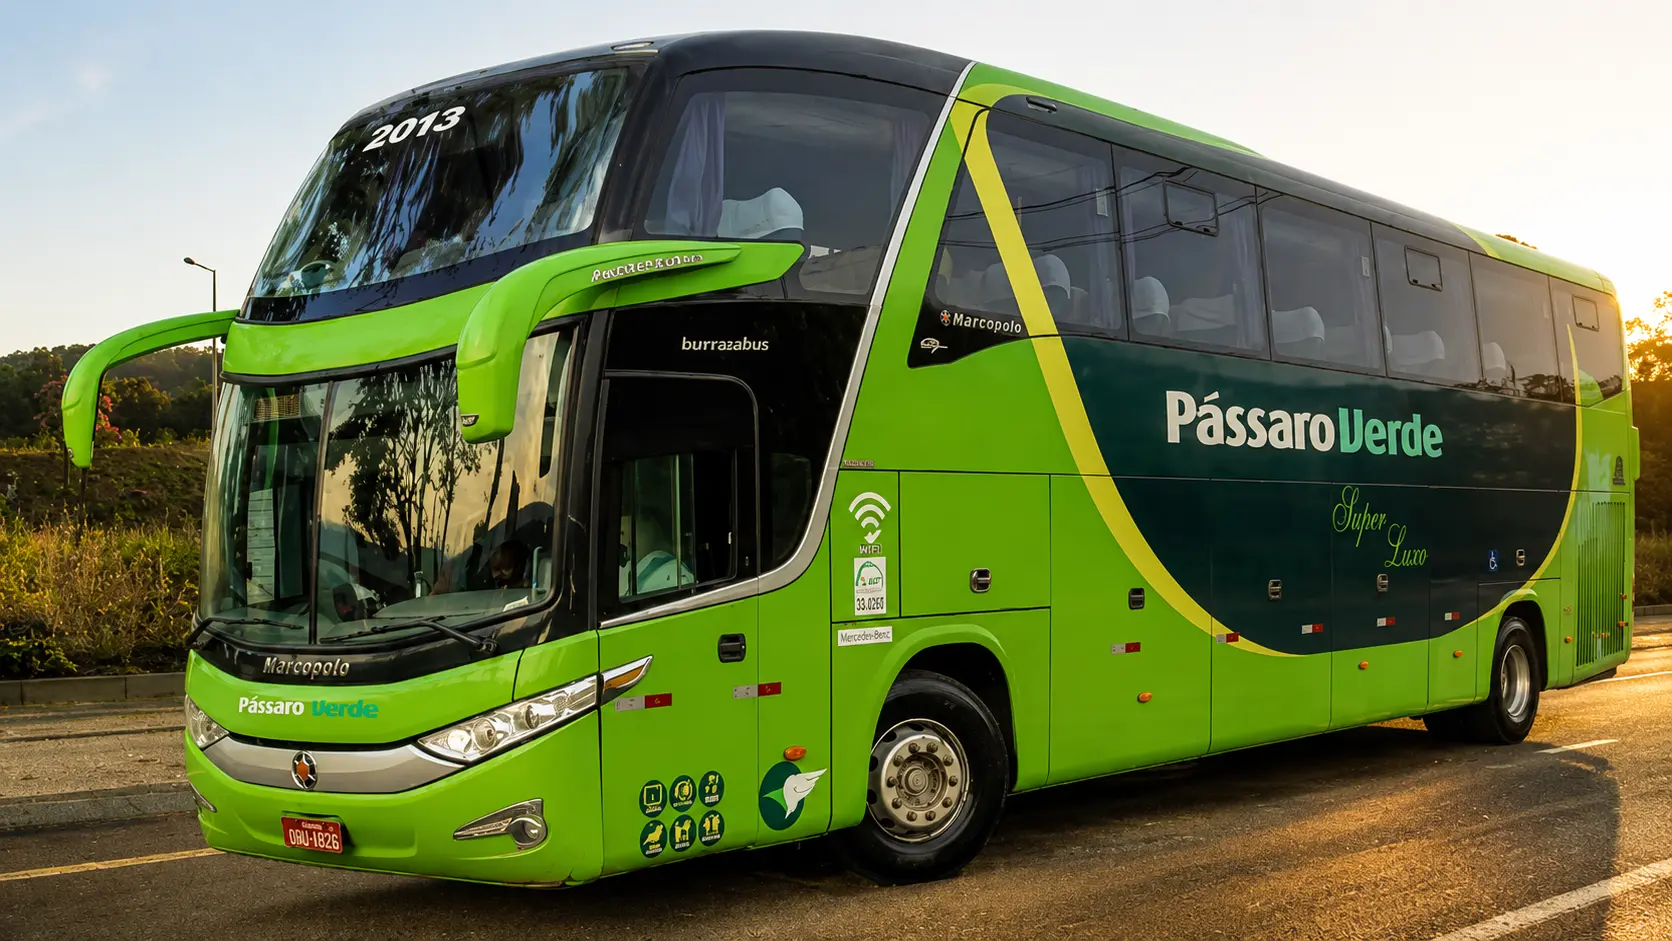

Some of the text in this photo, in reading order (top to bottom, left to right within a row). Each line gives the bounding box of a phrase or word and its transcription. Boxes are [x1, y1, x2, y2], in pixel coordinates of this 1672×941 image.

[362, 106, 466, 152] 2013
[952, 312, 1022, 333] Marcopolo
[1165, 390, 1444, 458] Pássaro Verde
[1332, 485, 1387, 548] Super
[1384, 523, 1428, 568] Luxo
[262, 657, 350, 680] Marcopolo
[238, 695, 379, 719] Pássaro Verde
